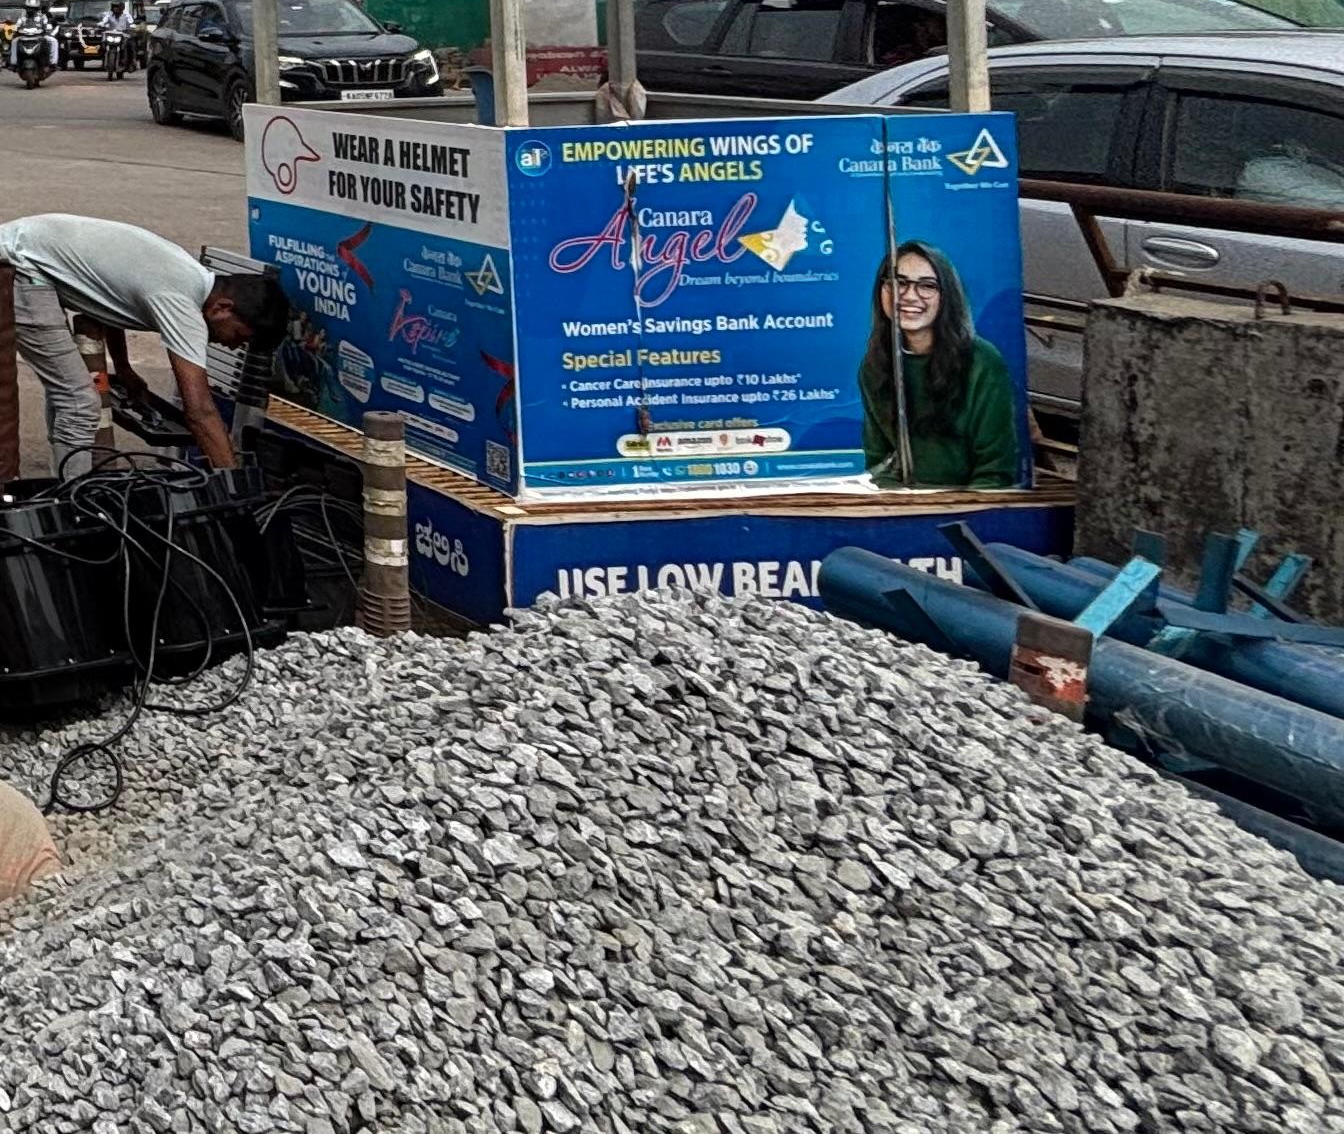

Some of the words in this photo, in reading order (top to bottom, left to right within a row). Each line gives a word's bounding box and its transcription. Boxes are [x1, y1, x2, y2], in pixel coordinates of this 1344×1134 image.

[332, 132, 379, 165] WEAR
[384, 139, 395, 168] A
[399, 141, 471, 178] HELMET
[562, 137, 706, 163] EMPOWERING
[709, 135, 782, 156] WINGS
[785, 134, 814, 154] OF
[679, 160, 763, 183] ANGELS
[902, 156, 943, 172] Bank
[328, 170, 358, 200] FOR
[360, 175, 406, 210] YOUR
[411, 183, 481, 224] SAFETY
[638, 207, 714, 228] Canara
[268, 234, 325, 259] FULFILLING
[549, 192, 758, 308] Angel
[275, 250, 340, 278] ASPIRATIONS
[403, 258, 437, 278] Canara
[438, 266, 463, 285] Bank
[295, 268, 357, 306] YOUNG
[679, 272, 723, 287] Dream
[724, 270, 770, 287] beyond
[772, 269, 840, 284] boundaries
[314, 296, 351, 323] INDIA
[563, 319, 642, 337] Women's
[644, 317, 713, 336] Savings
[716, 314, 760, 331] Bank
[763, 312, 834, 330] Account
[562, 350, 633, 372] Special
[636, 347, 722, 366] Features
[569, 379, 611, 393] Cancer
[613, 377, 642, 391] Care
[643, 376, 702, 390] Insurance
[704, 375, 733, 389] upto
[570, 395, 623, 410] Personal
[624, 393, 679, 407] Accident
[681, 392, 739, 405] Insurance
[740, 391, 770, 404] upto
[698, 418, 724, 430] card
[724, 417, 760, 429] offers
[714, 462, 741, 475] 1030
[415, 519, 470, 577] ಚಲಿಸಿ
[557, 567, 628, 600] USE
[637, 563, 724, 595] LOW
